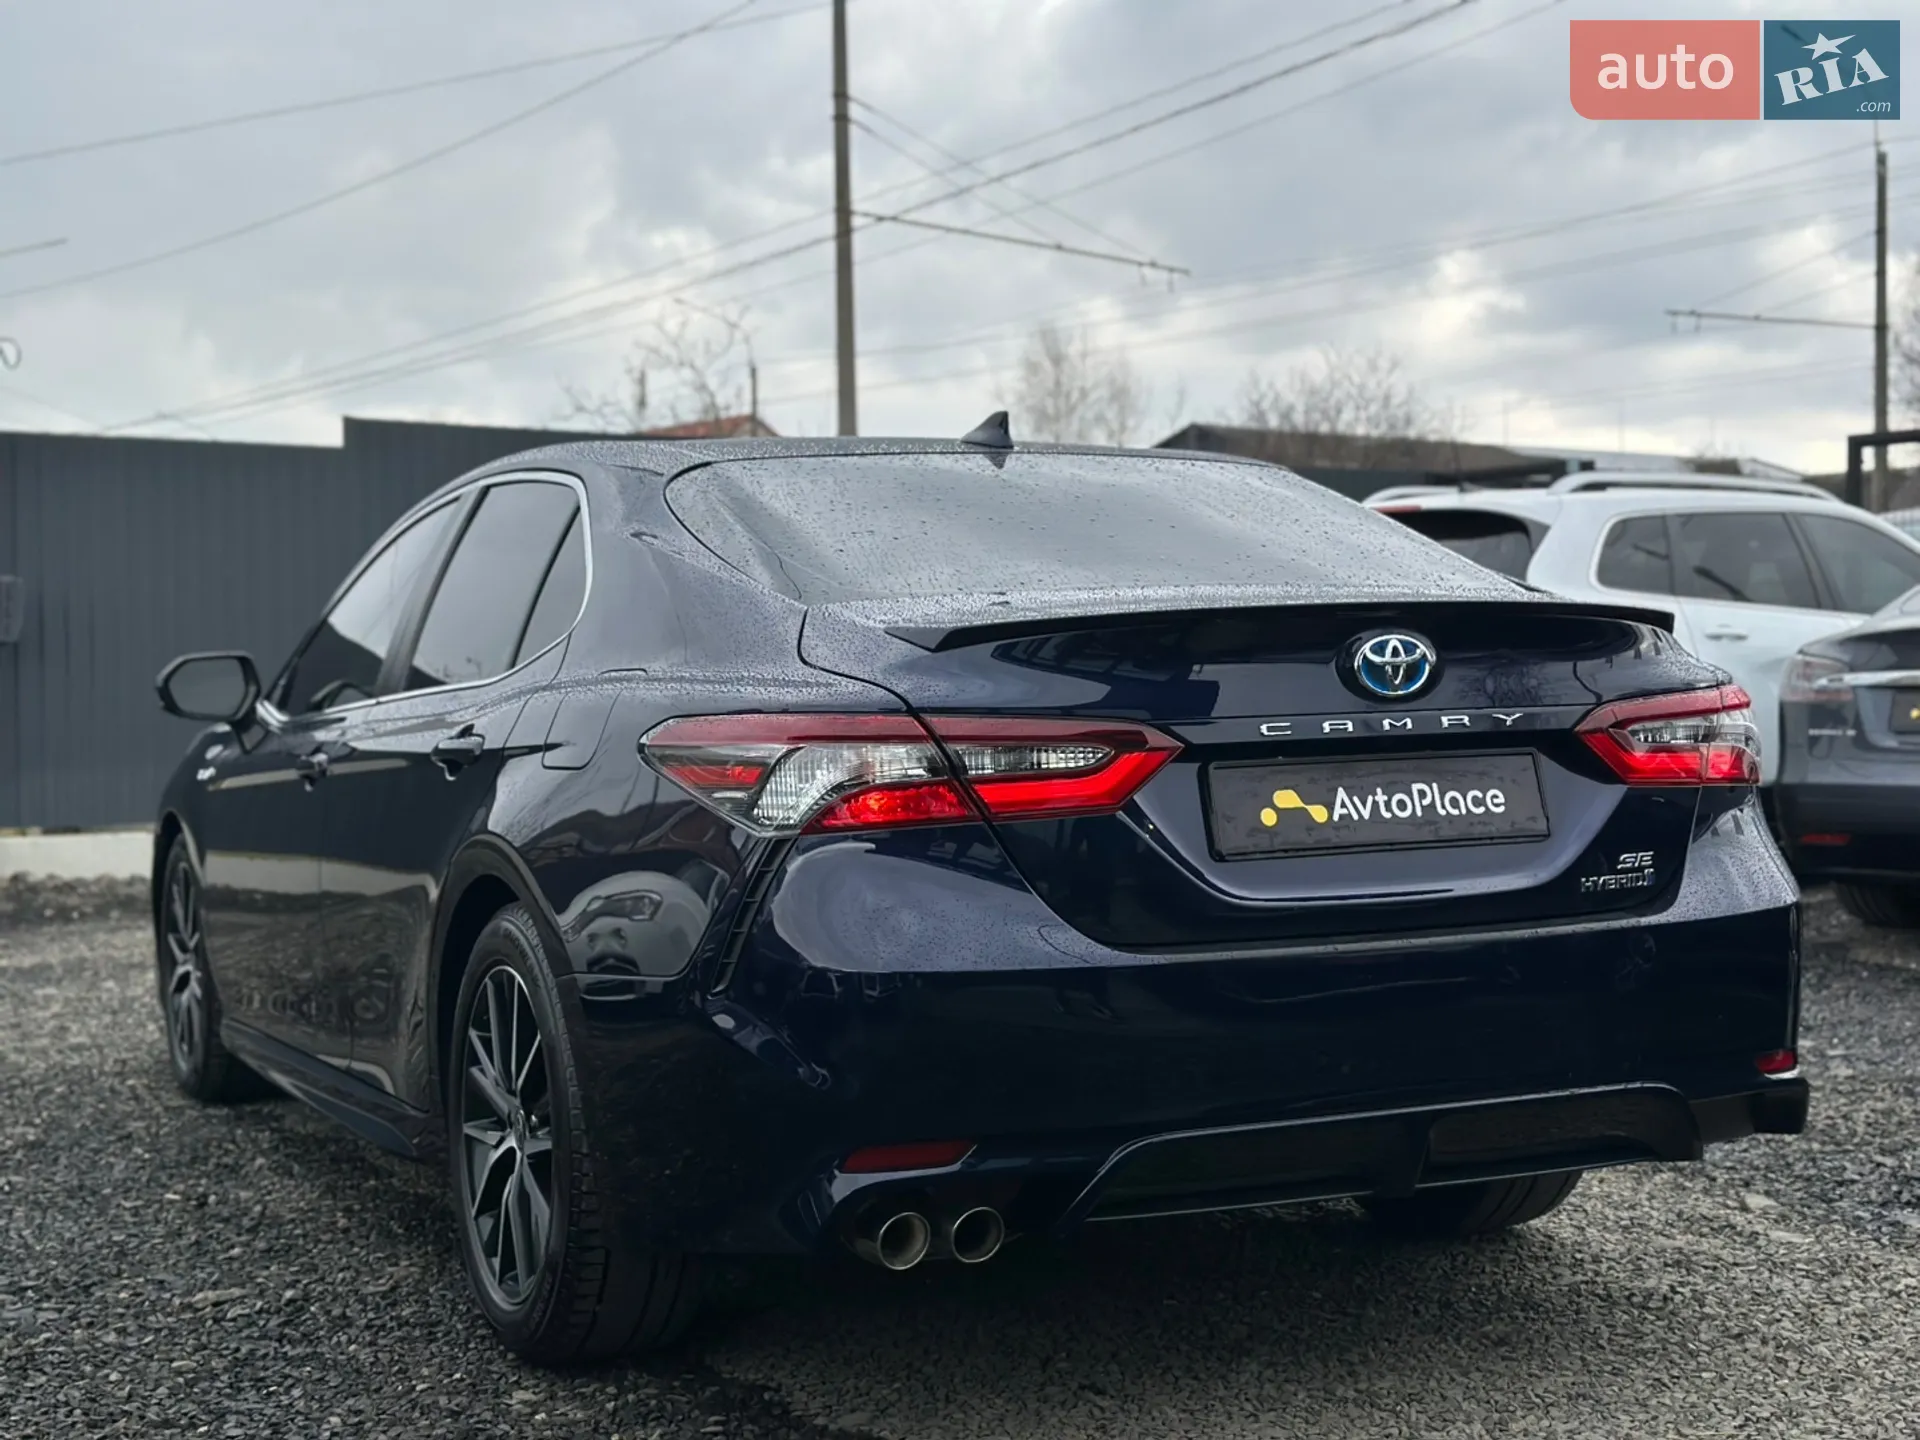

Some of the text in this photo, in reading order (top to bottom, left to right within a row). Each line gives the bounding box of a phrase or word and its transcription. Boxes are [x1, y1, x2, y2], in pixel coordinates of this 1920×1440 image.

[1259, 712, 1524, 736] CAMRY
[1332, 782, 1506, 822] AvtoPlace
[1616, 850, 1655, 870] SE
[1580, 872, 1643, 893] HYBRID
